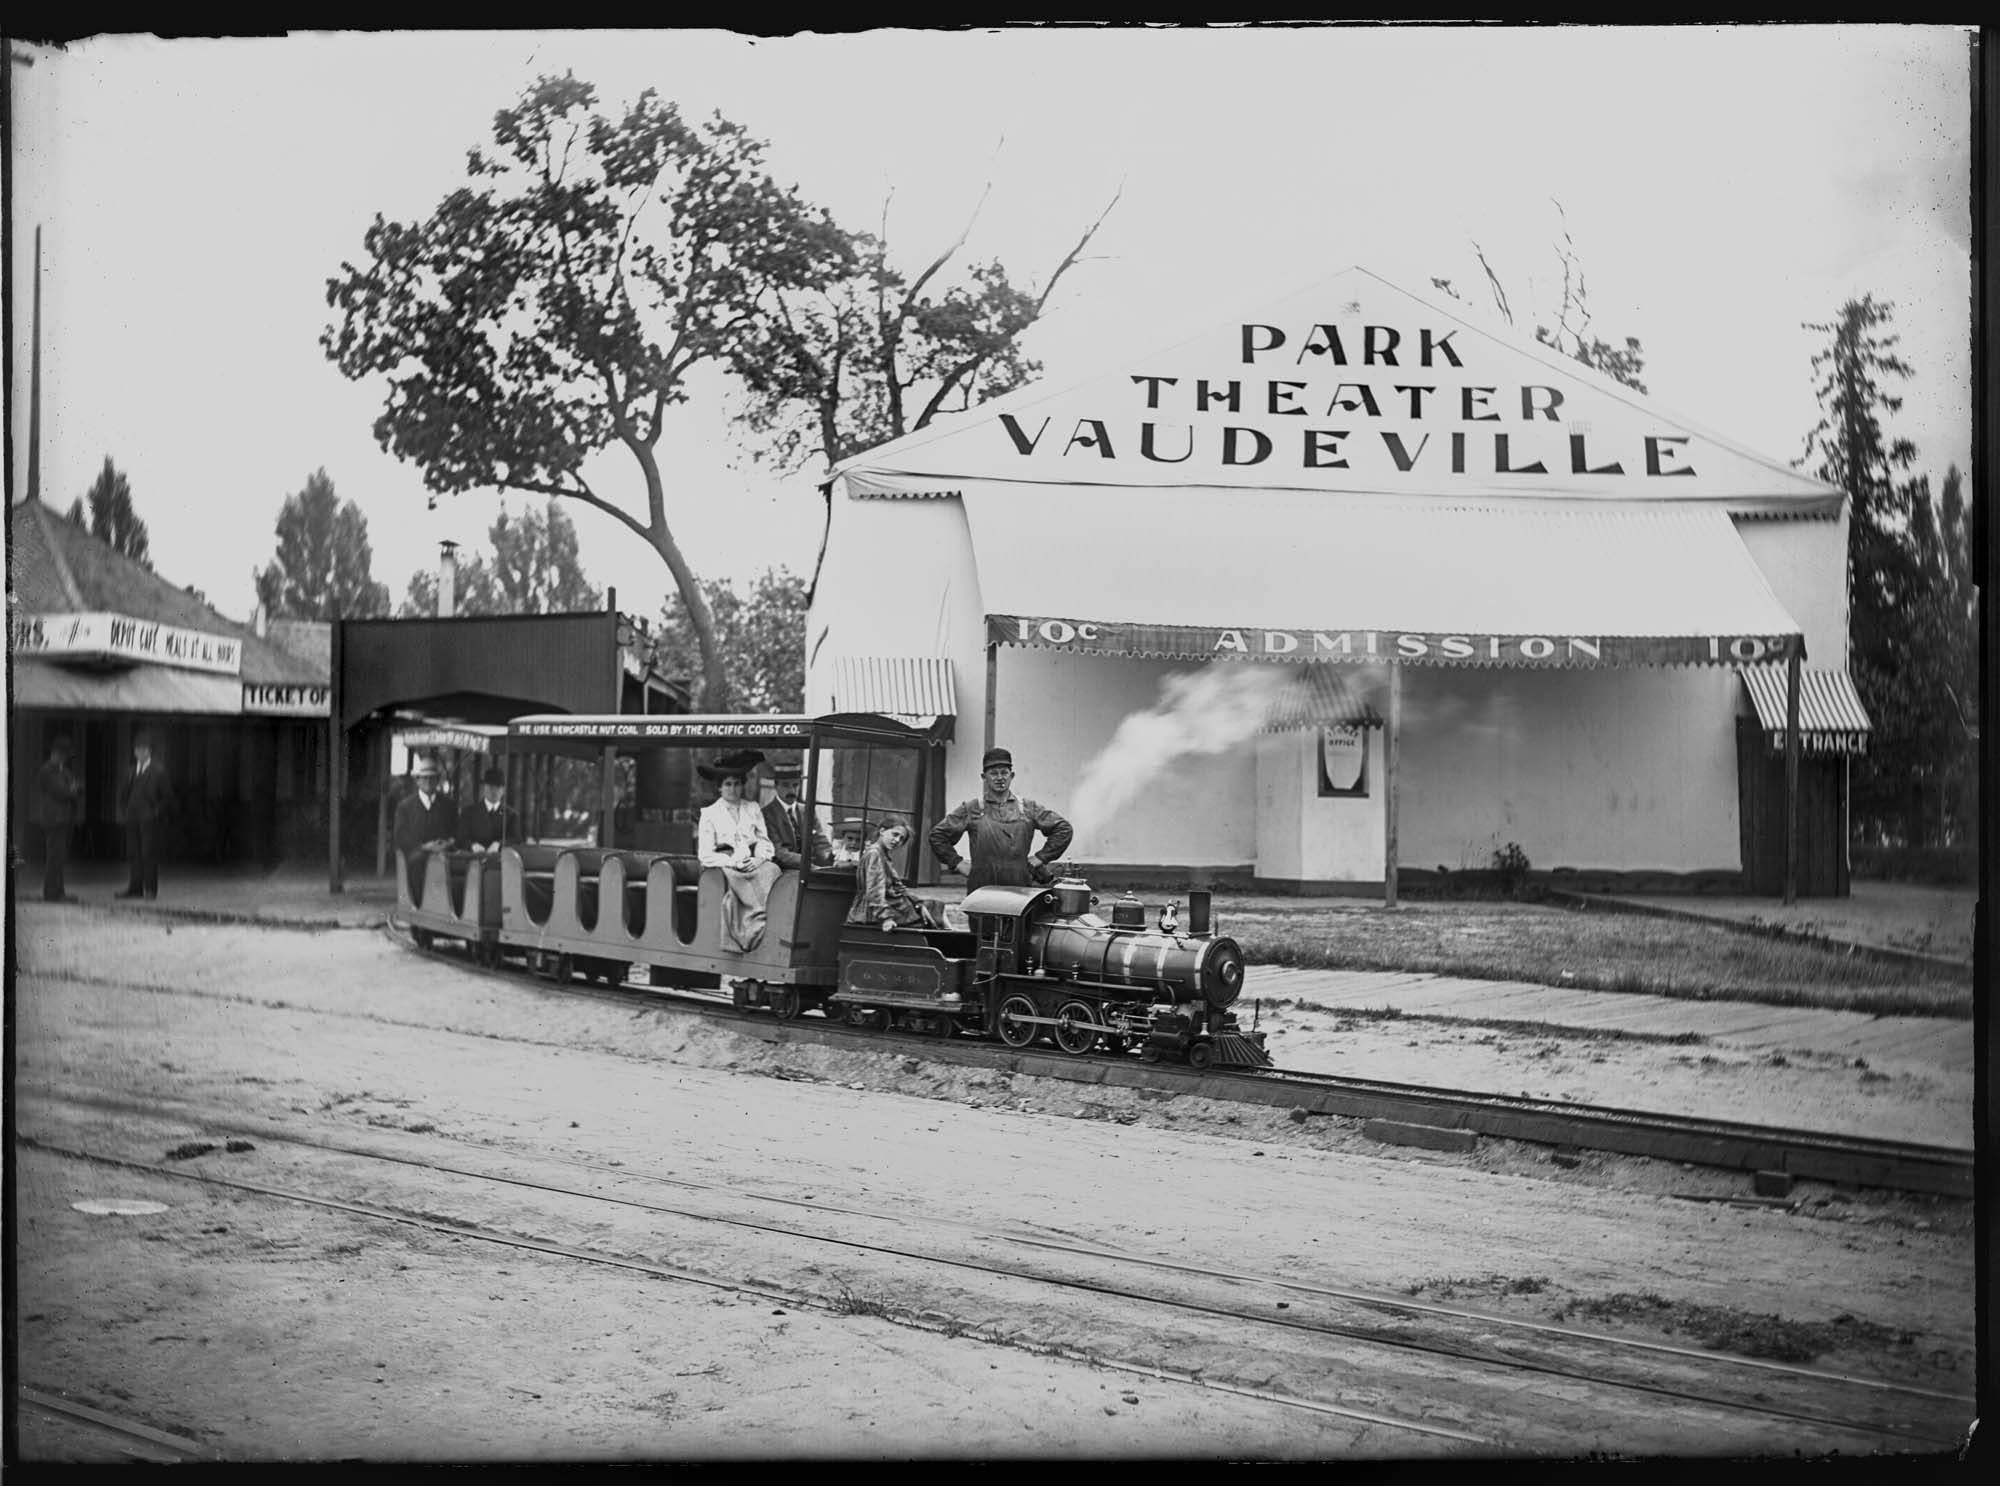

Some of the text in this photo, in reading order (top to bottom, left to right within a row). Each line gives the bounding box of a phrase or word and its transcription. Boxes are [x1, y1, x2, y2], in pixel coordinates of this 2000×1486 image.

[1240, 323, 1464, 368] PARK
[1130, 375, 1565, 422] THEATER
[998, 413, 1698, 478] VAUDEVILLE
[111, 617, 136, 649] DEPOT
[1213, 629, 1600, 660] ADMISSION
[249, 686, 304, 706] TICKET
[519, 724, 801, 735] WE USE NEWCASTLE NUT COAL SOLD BY THE PACIFIC COAST CO.
